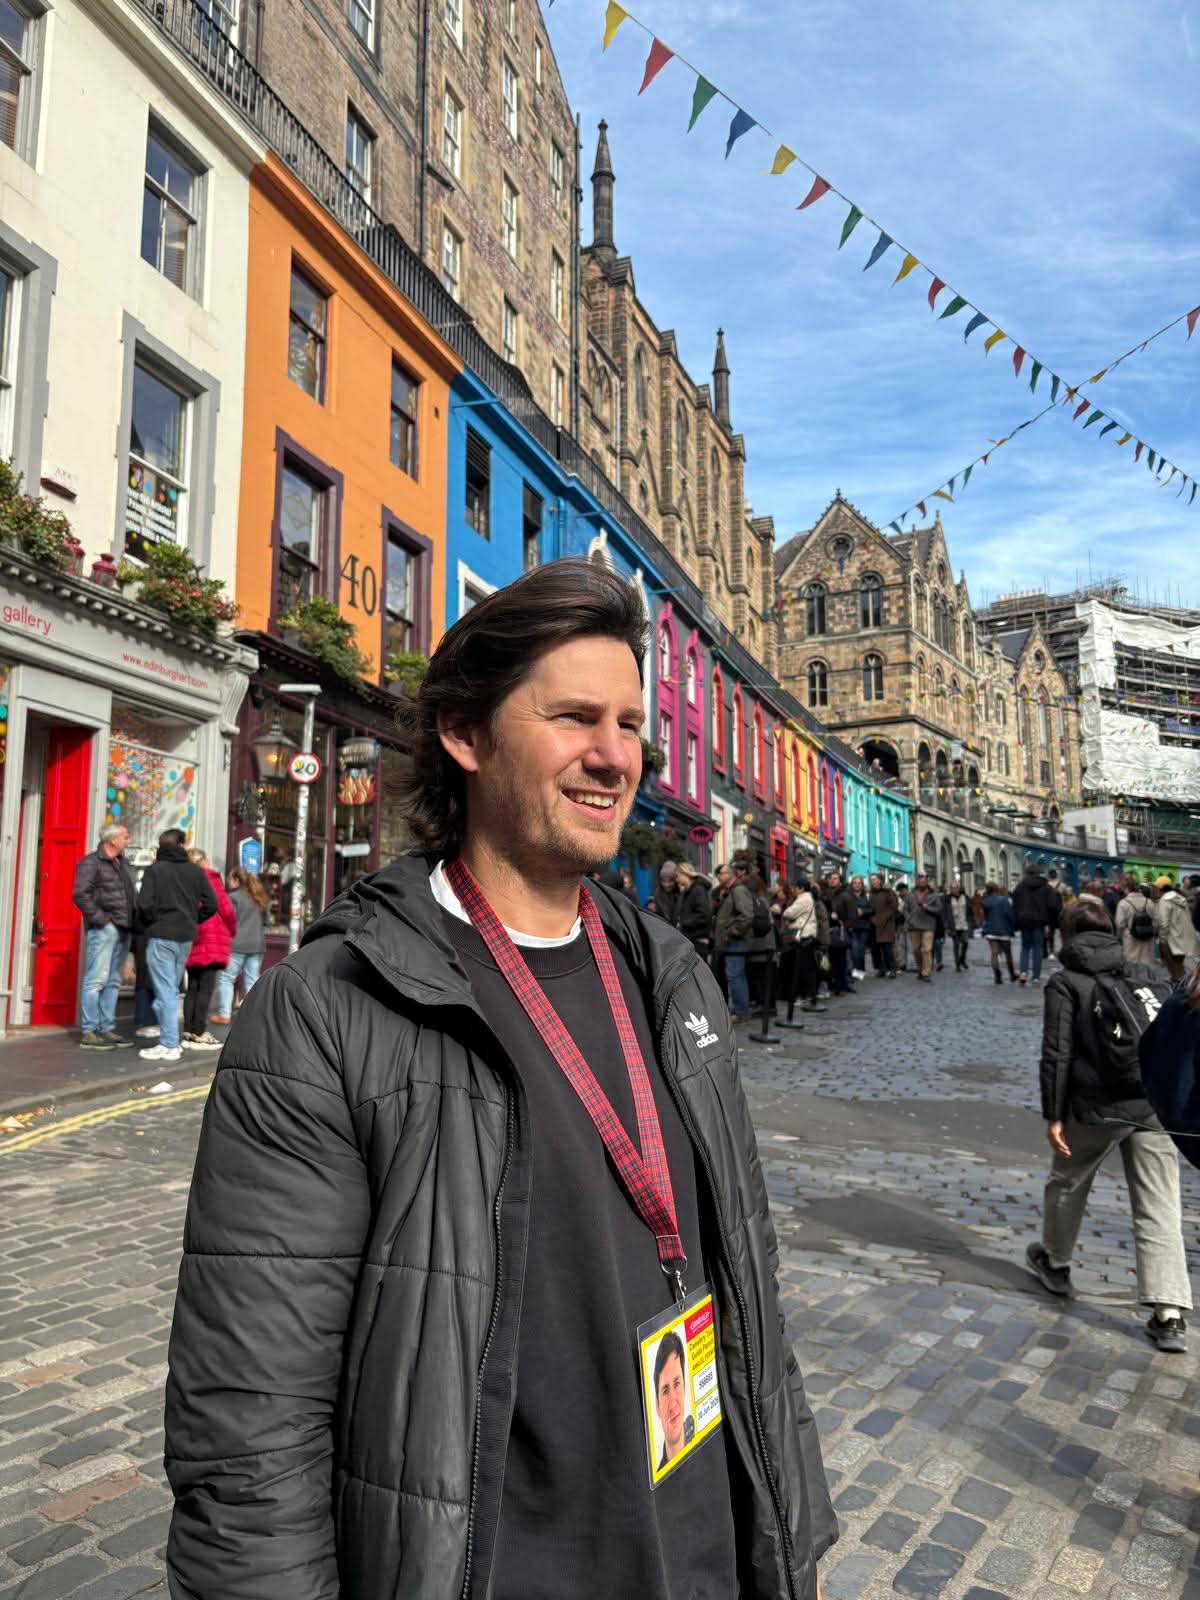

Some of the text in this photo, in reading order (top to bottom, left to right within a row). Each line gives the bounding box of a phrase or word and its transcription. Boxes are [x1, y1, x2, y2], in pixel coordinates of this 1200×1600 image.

[341, 553, 377, 616] 40
[3, 604, 52, 636] gallery
[696, 1033, 719, 1048] adidas
